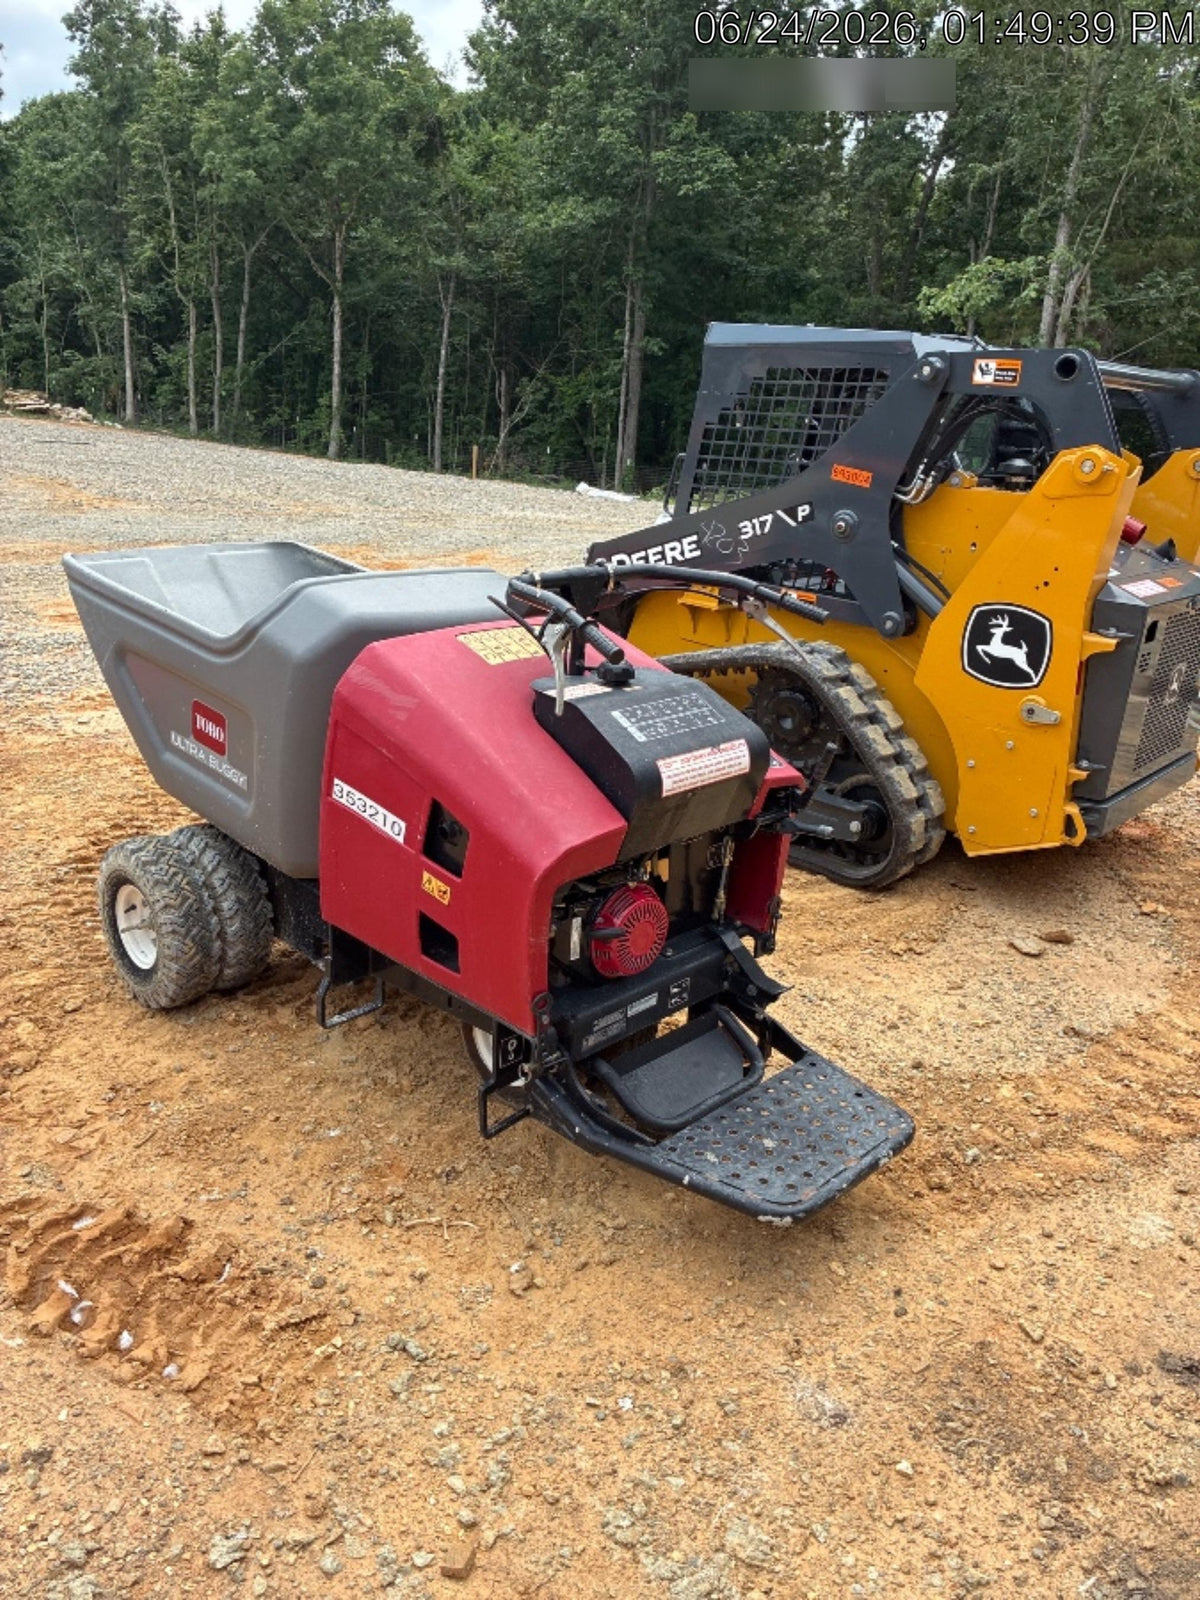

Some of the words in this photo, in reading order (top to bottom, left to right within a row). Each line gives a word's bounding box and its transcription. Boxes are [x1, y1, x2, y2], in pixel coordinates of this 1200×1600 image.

[738, 513, 773, 539] 317
[194, 712, 225, 742] TORO
[170, 730, 207, 763] ULTRA
[208, 754, 248, 786] BUGGY
[333, 783, 403, 837] 353210
